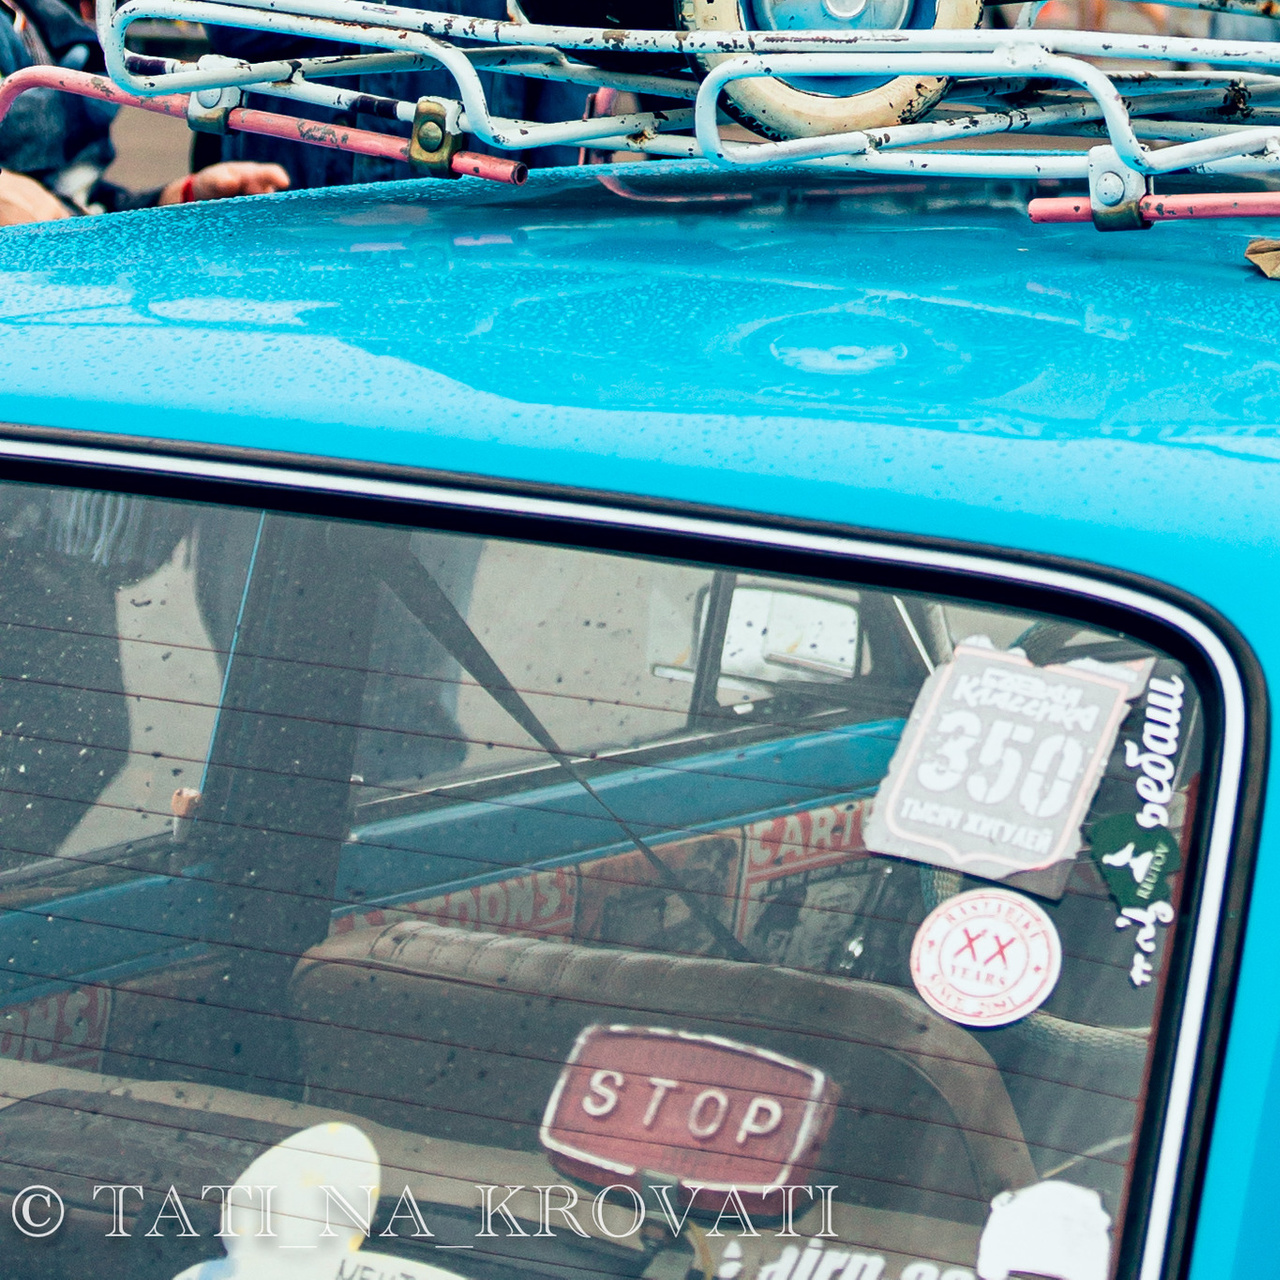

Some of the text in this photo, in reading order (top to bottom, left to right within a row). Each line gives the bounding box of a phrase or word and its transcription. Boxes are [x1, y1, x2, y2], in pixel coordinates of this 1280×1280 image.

[917, 709, 1084, 819] 350
[1136, 841, 1171, 900] REUTOV
[950, 964, 1006, 987] YEARS
[954, 927, 1016, 970] XX
[581, 1069, 784, 1144] STOP
